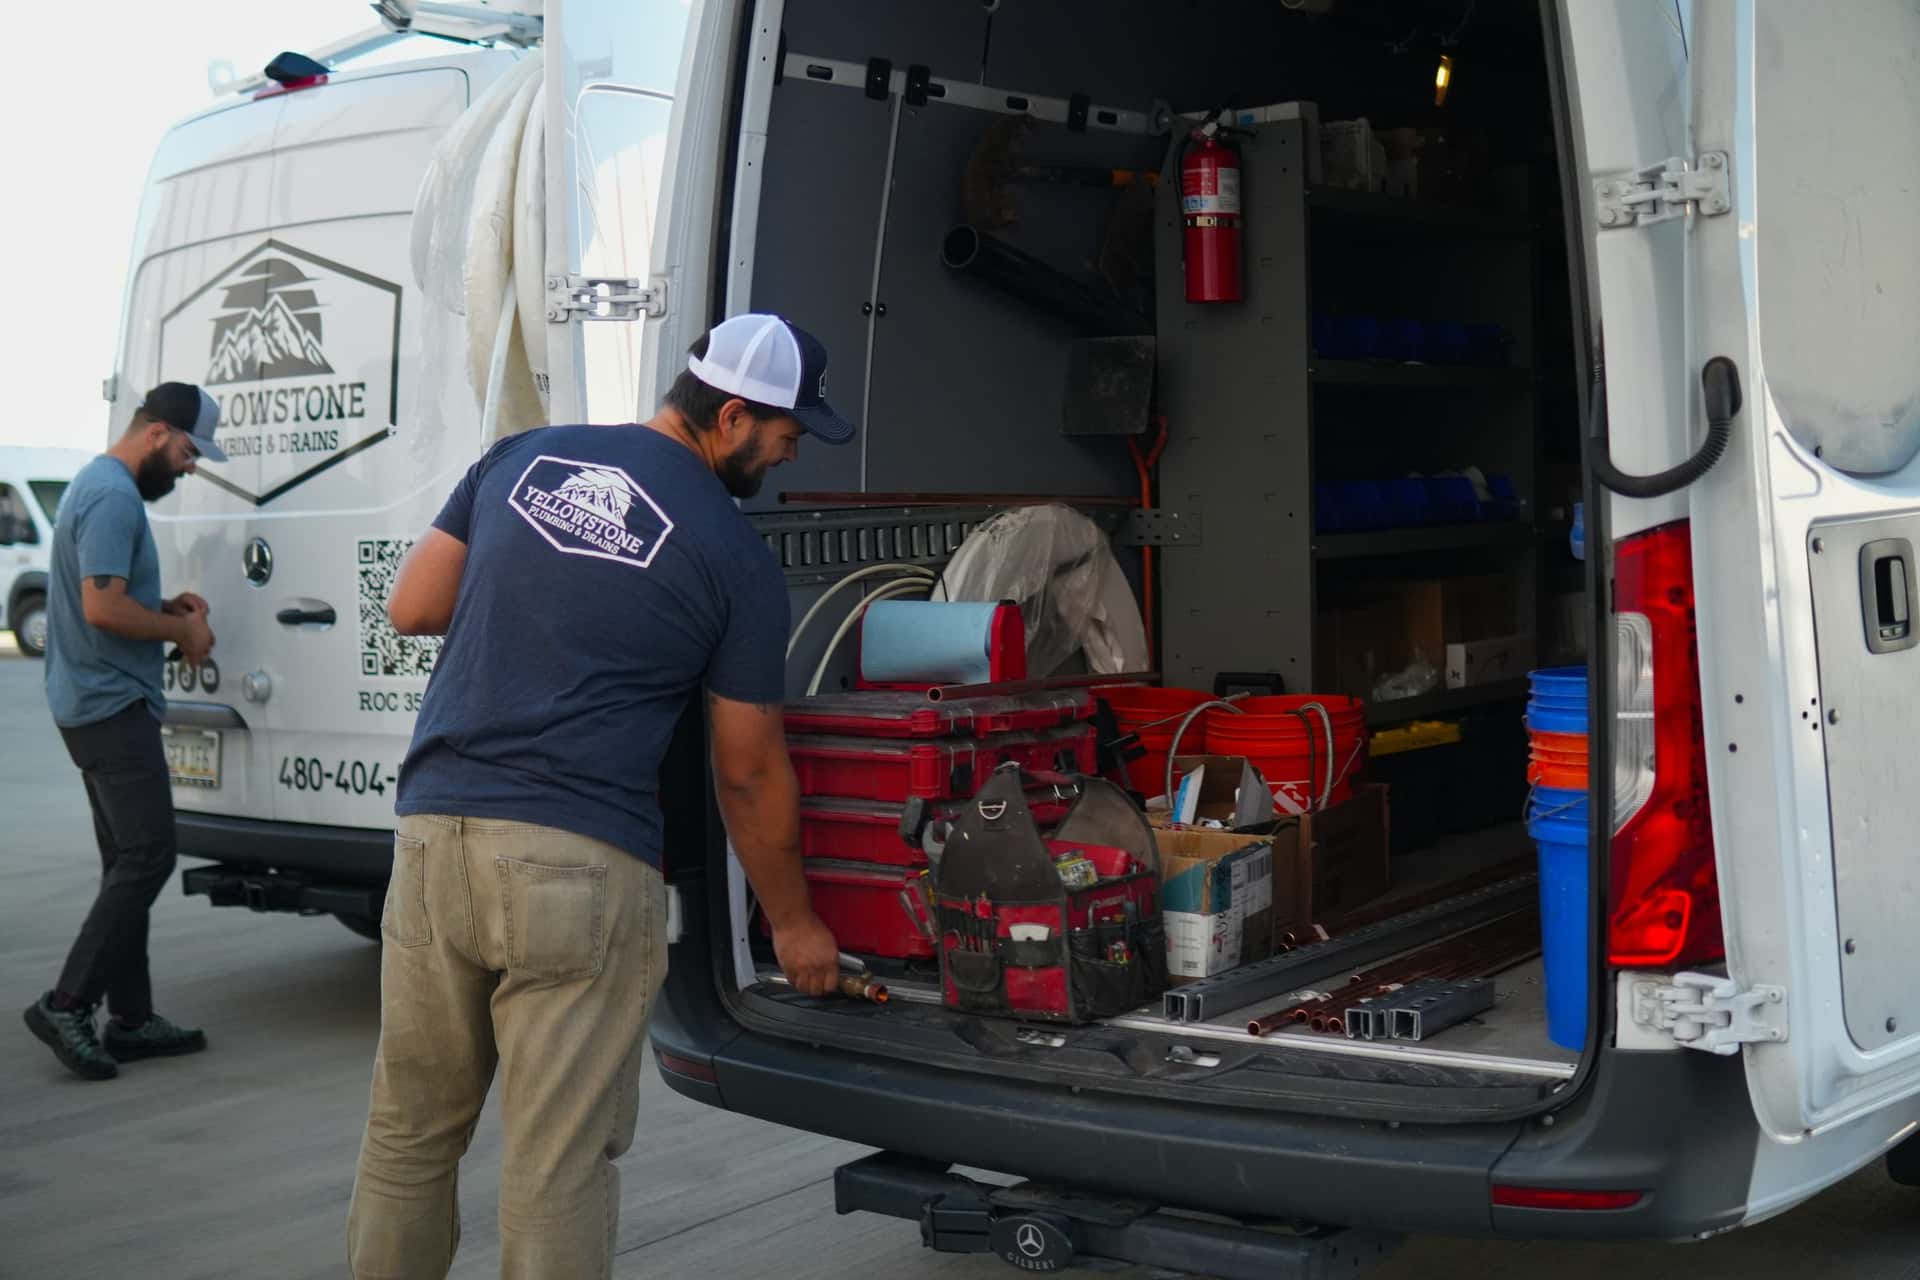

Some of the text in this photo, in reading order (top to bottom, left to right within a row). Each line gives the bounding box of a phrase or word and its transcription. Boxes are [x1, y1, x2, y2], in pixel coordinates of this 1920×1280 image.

[216, 382, 366, 428] LOWSTONE
[267, 436, 275, 454] &
[279, 430, 339, 454] DRAINS
[523, 485, 645, 555] YELLOWSTONE
[527, 507, 621, 556] PLUMBING & DRAINS
[359, 691, 423, 712] ROC 35
[279, 756, 403, 797] 480-404-
[1007, 1251, 1056, 1271] GILBERT
